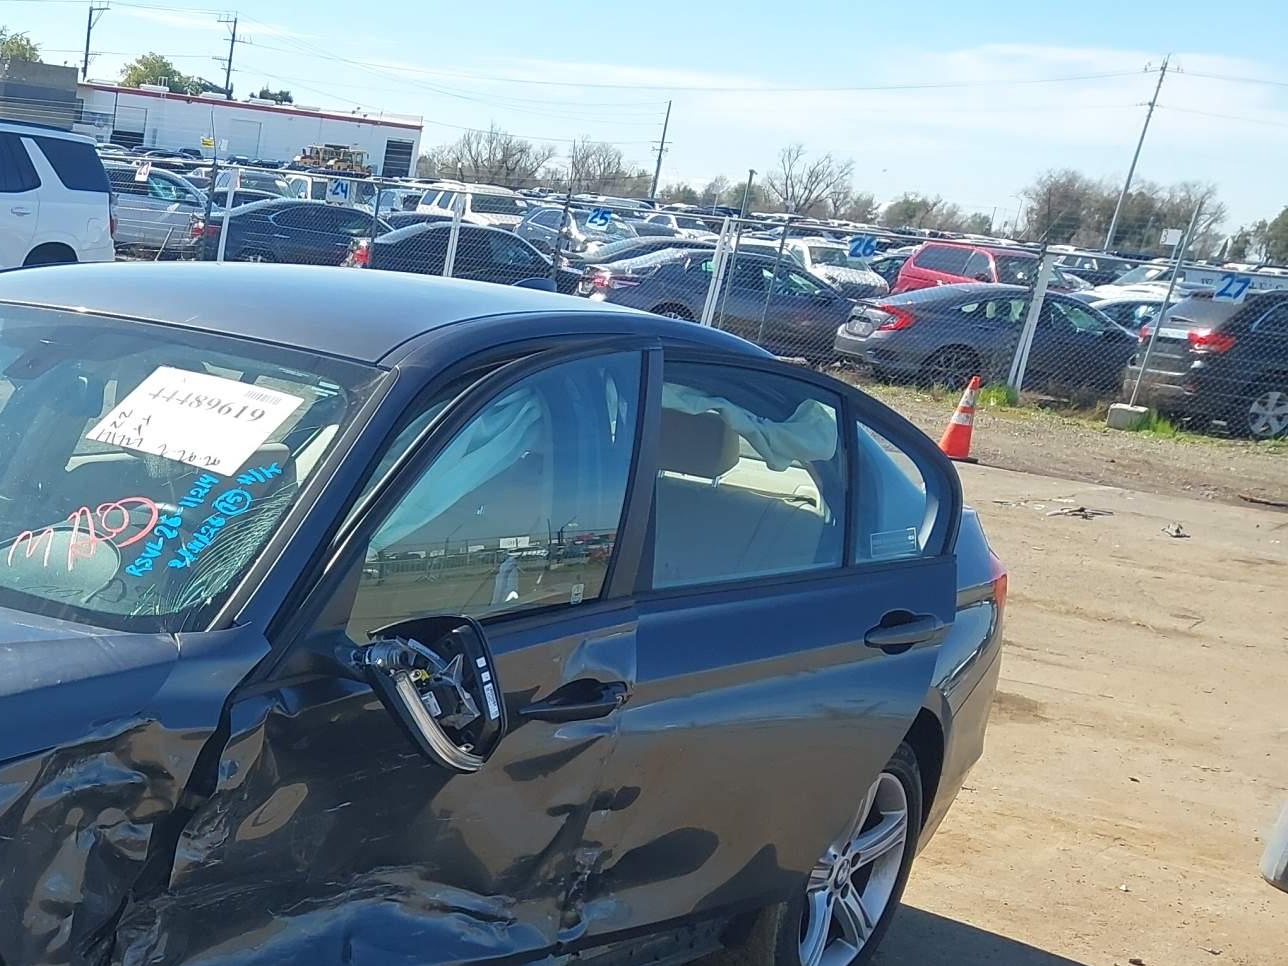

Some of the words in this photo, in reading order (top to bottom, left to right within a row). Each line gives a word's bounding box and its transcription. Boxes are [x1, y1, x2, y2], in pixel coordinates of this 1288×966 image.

[332, 178, 349, 200] 24
[588, 208, 612, 227] 25
[848, 236, 876, 257] 26
[1215, 272, 1252, 300] 27
[148, 387, 265, 422] 44489619
